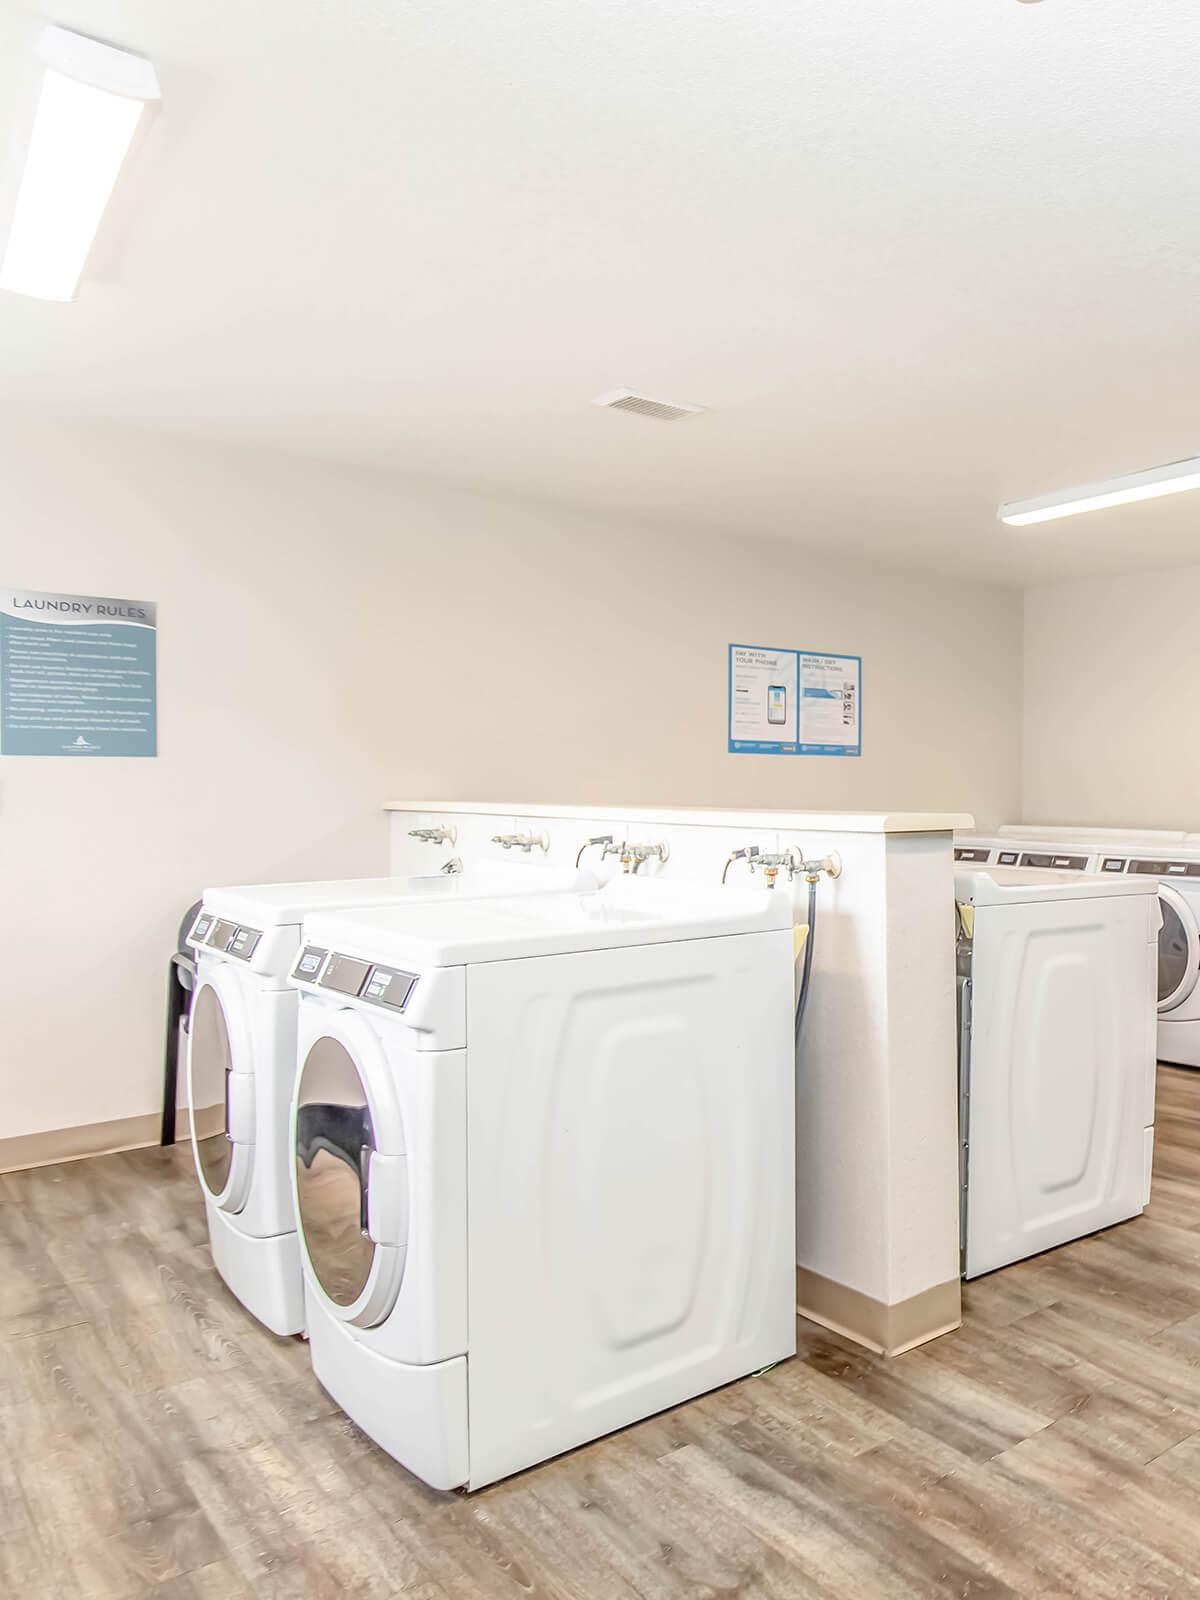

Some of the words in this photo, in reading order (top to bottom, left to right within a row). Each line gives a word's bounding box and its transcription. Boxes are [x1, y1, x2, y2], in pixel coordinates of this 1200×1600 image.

[13, 597, 94, 614] LAUNDRY
[96, 605, 146, 619] RULES
[755, 658, 777, 666] PHONE
